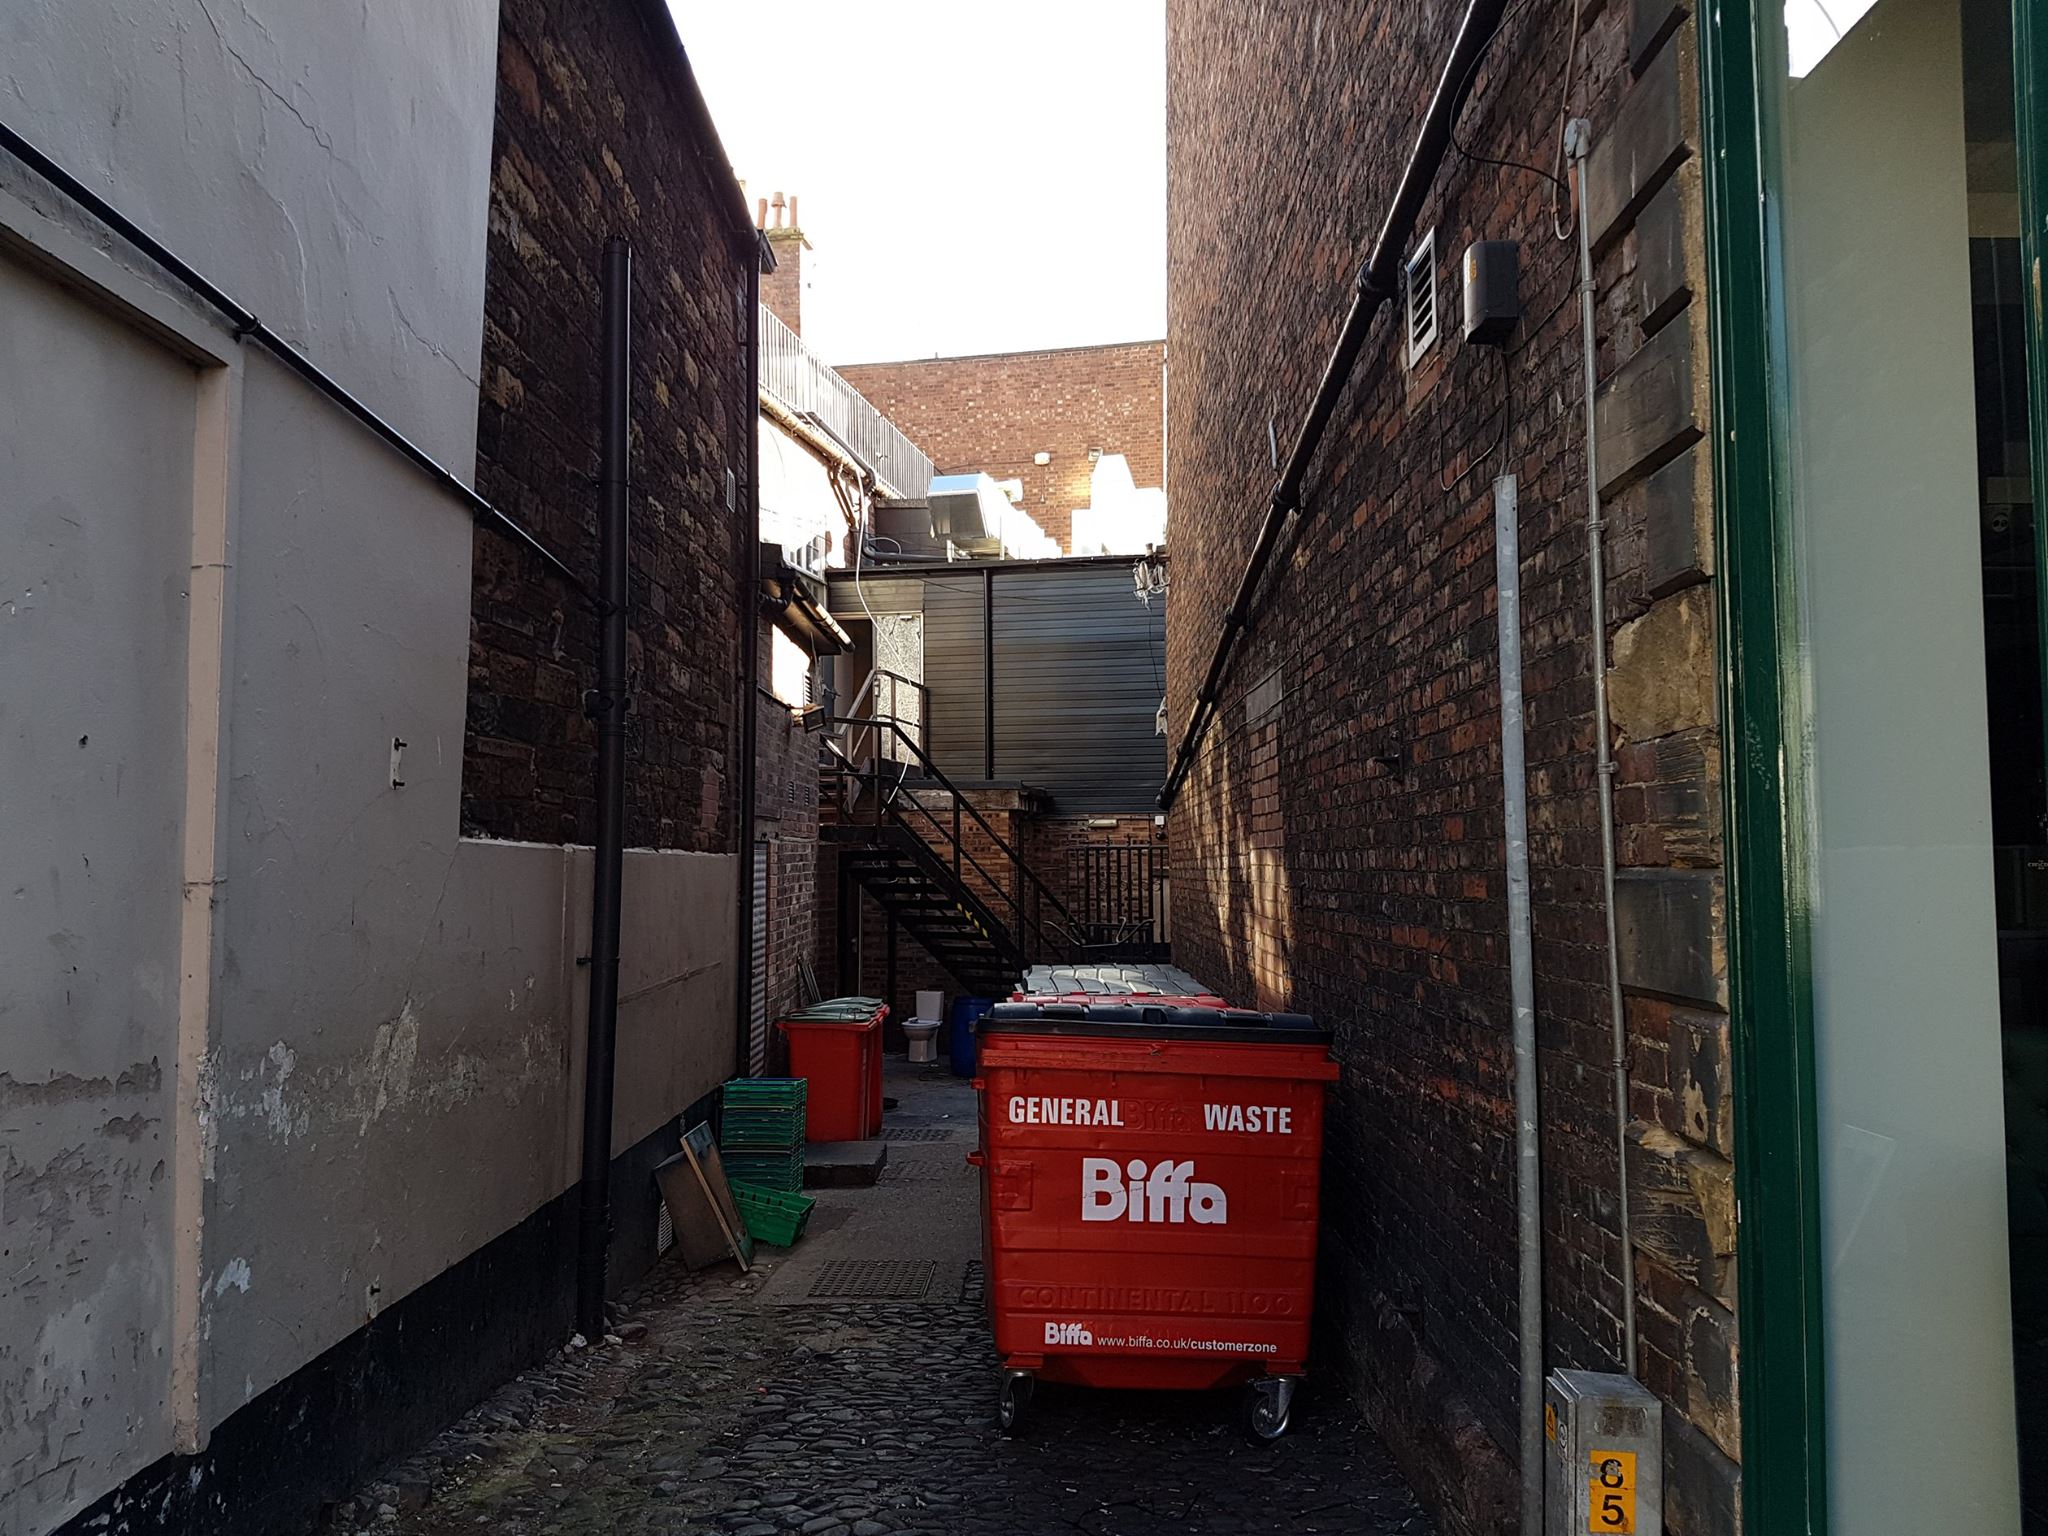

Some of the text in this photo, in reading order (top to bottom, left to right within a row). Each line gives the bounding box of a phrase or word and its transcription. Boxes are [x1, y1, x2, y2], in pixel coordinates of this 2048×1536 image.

[1008, 1096, 1292, 1134] GENERAL WASTE
[1123, 1100, 1193, 1132] Biffa
[1081, 1157, 1227, 1224] Biffa
[1018, 1286, 1216, 1313] CONTINENTAL
[1044, 1321, 1278, 1353] Biffa www.biffa.co.uk/customerzone
[1601, 1494, 1625, 1526] 5
